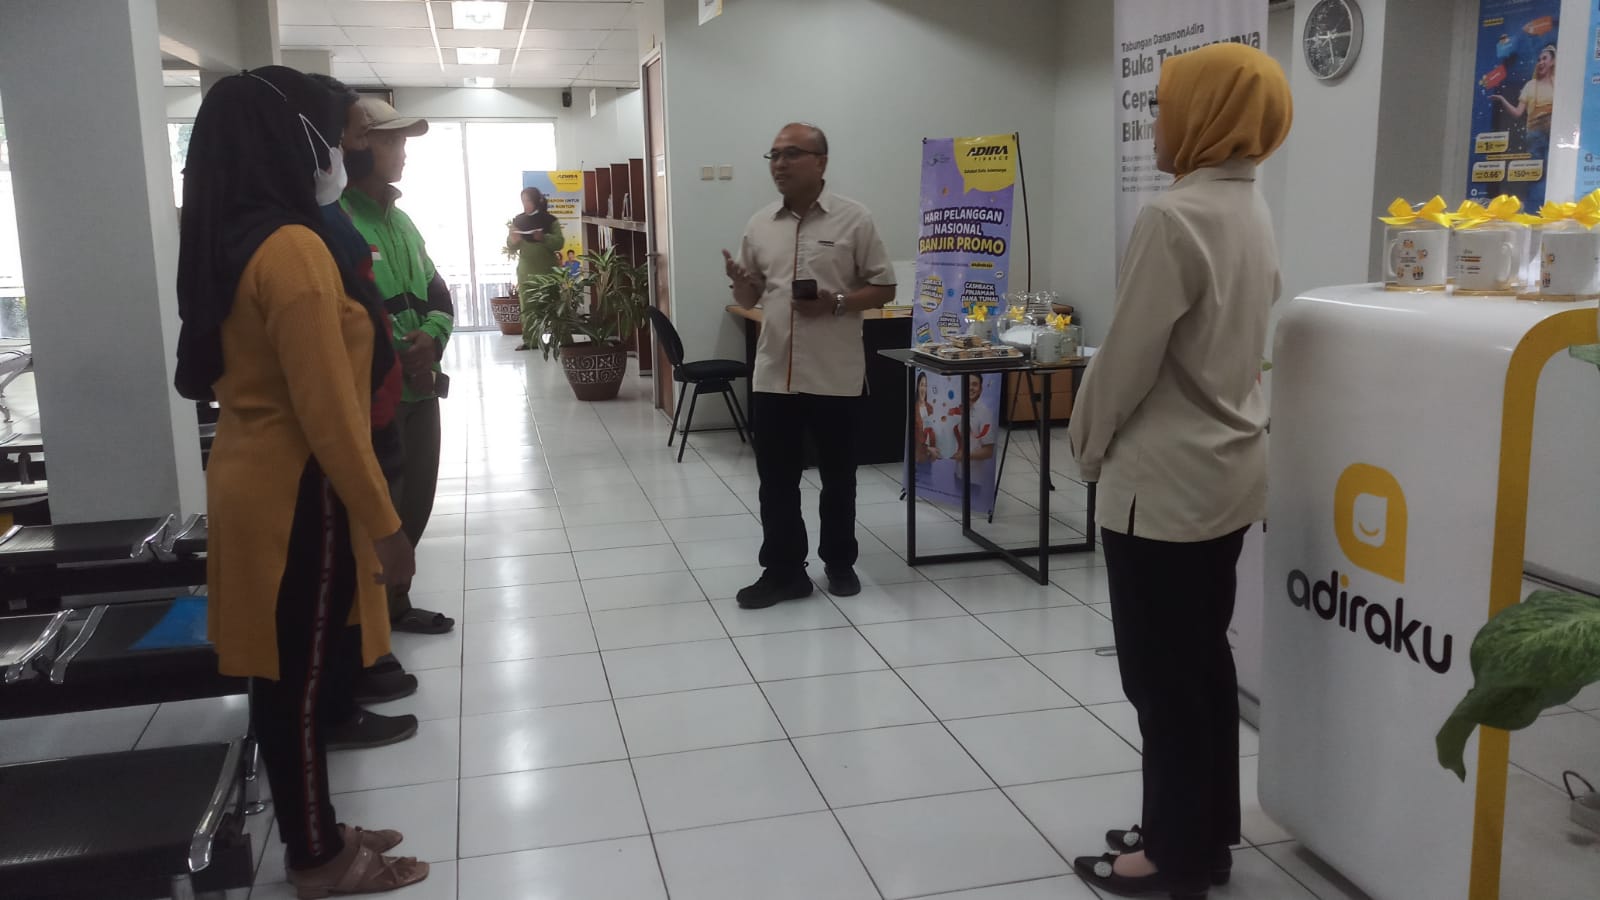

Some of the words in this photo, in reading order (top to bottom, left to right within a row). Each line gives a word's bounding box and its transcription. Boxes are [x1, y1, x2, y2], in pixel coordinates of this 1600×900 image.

[1121, 38, 1152, 53] Tabungan
[1153, 23, 1204, 45] DanamonAdira
[1122, 52, 1153, 78] Buka
[966, 145, 1008, 157] ADIRA
[924, 210, 943, 223] HARI
[944, 208, 1002, 222] PELANGGAN
[934, 223, 982, 235] NASIONAL
[920, 237, 954, 252] BANJIR
[956, 237, 1004, 254] PROMO
[1287, 569, 1452, 674] adiraku
